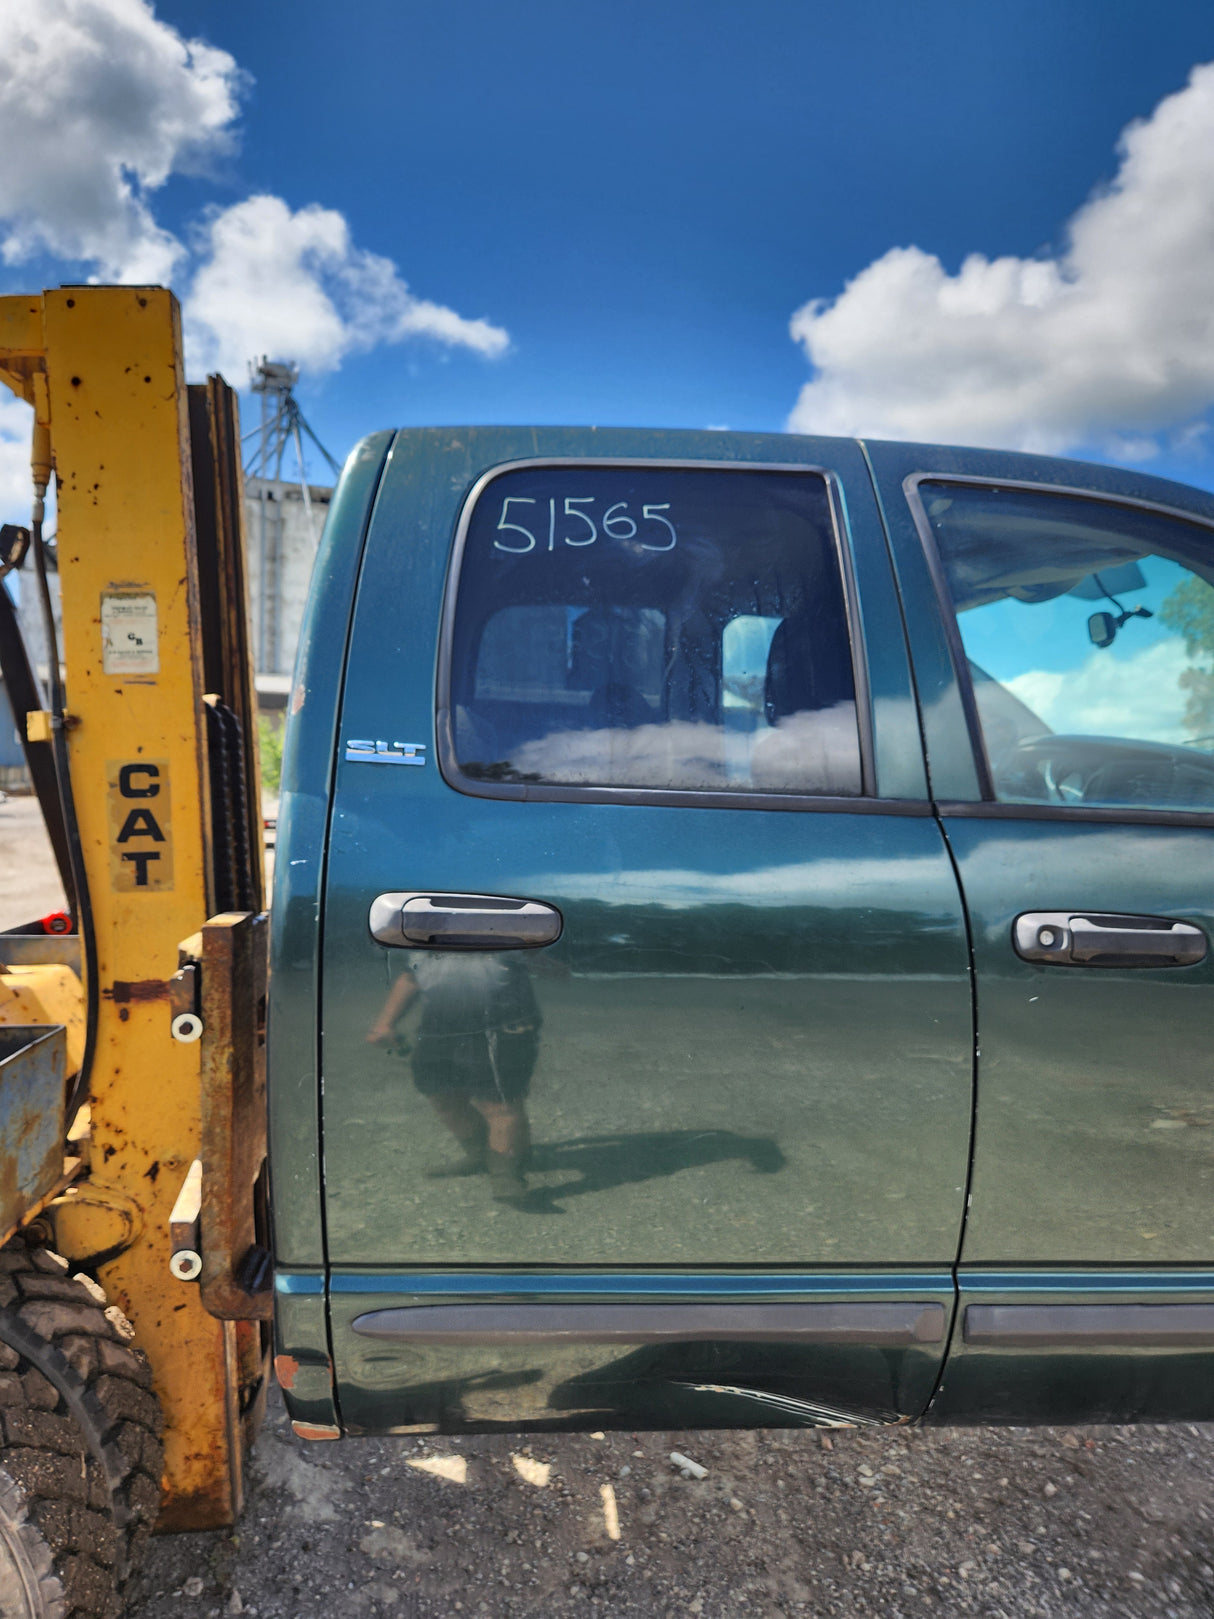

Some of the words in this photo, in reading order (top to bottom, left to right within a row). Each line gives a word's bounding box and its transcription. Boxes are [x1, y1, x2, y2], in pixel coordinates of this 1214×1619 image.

[494, 497, 677, 553] 51565
[345, 740, 426, 758] SLT
[116, 764, 166, 886] CAT
